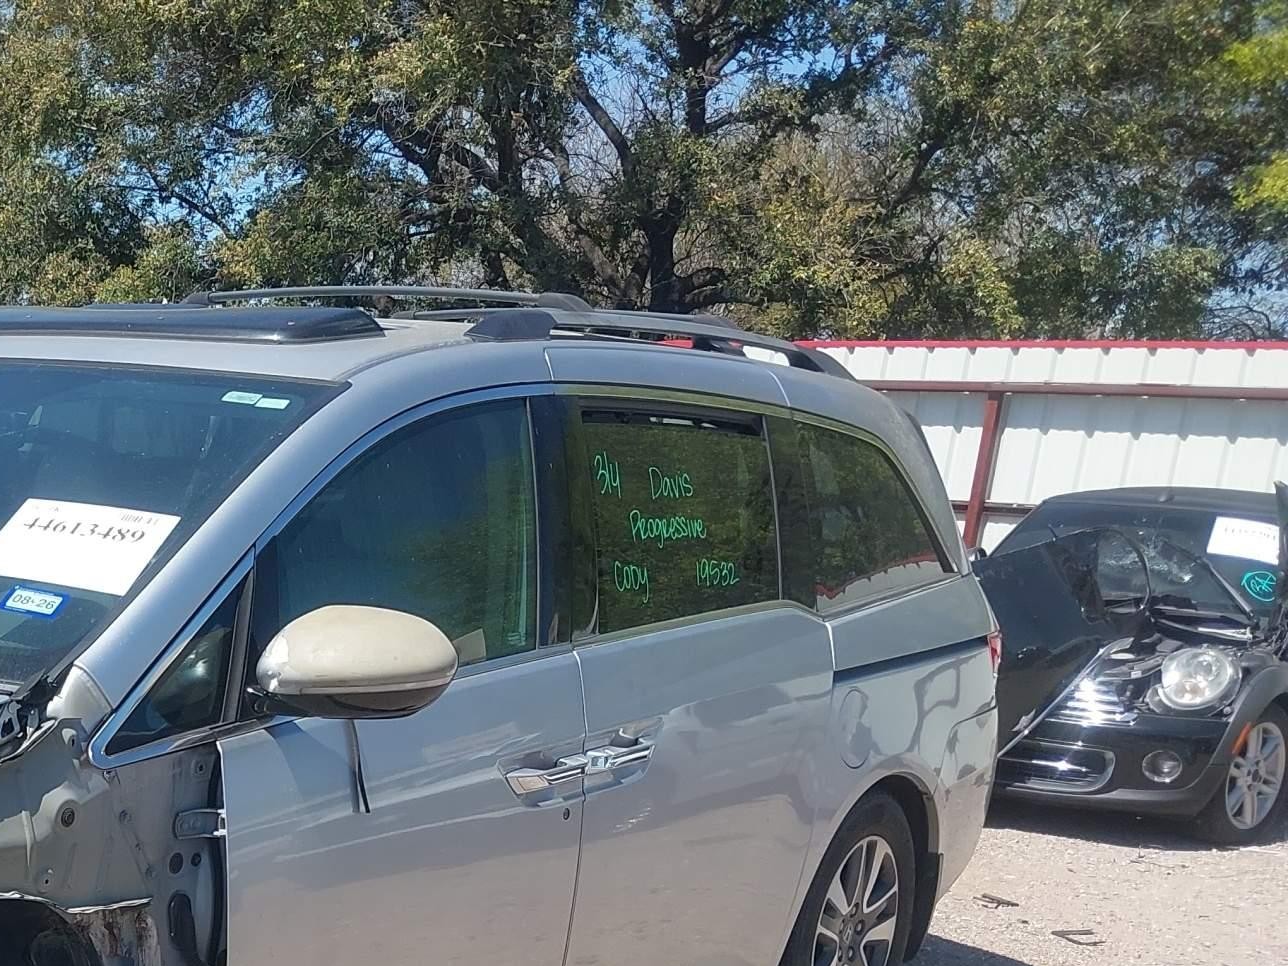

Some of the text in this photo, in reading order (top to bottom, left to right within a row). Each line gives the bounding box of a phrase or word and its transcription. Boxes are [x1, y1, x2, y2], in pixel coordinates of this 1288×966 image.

[594, 451, 694, 500] 3/4 Davis
[23, 516, 146, 543] 44613489
[696, 559, 740, 587] 19532
